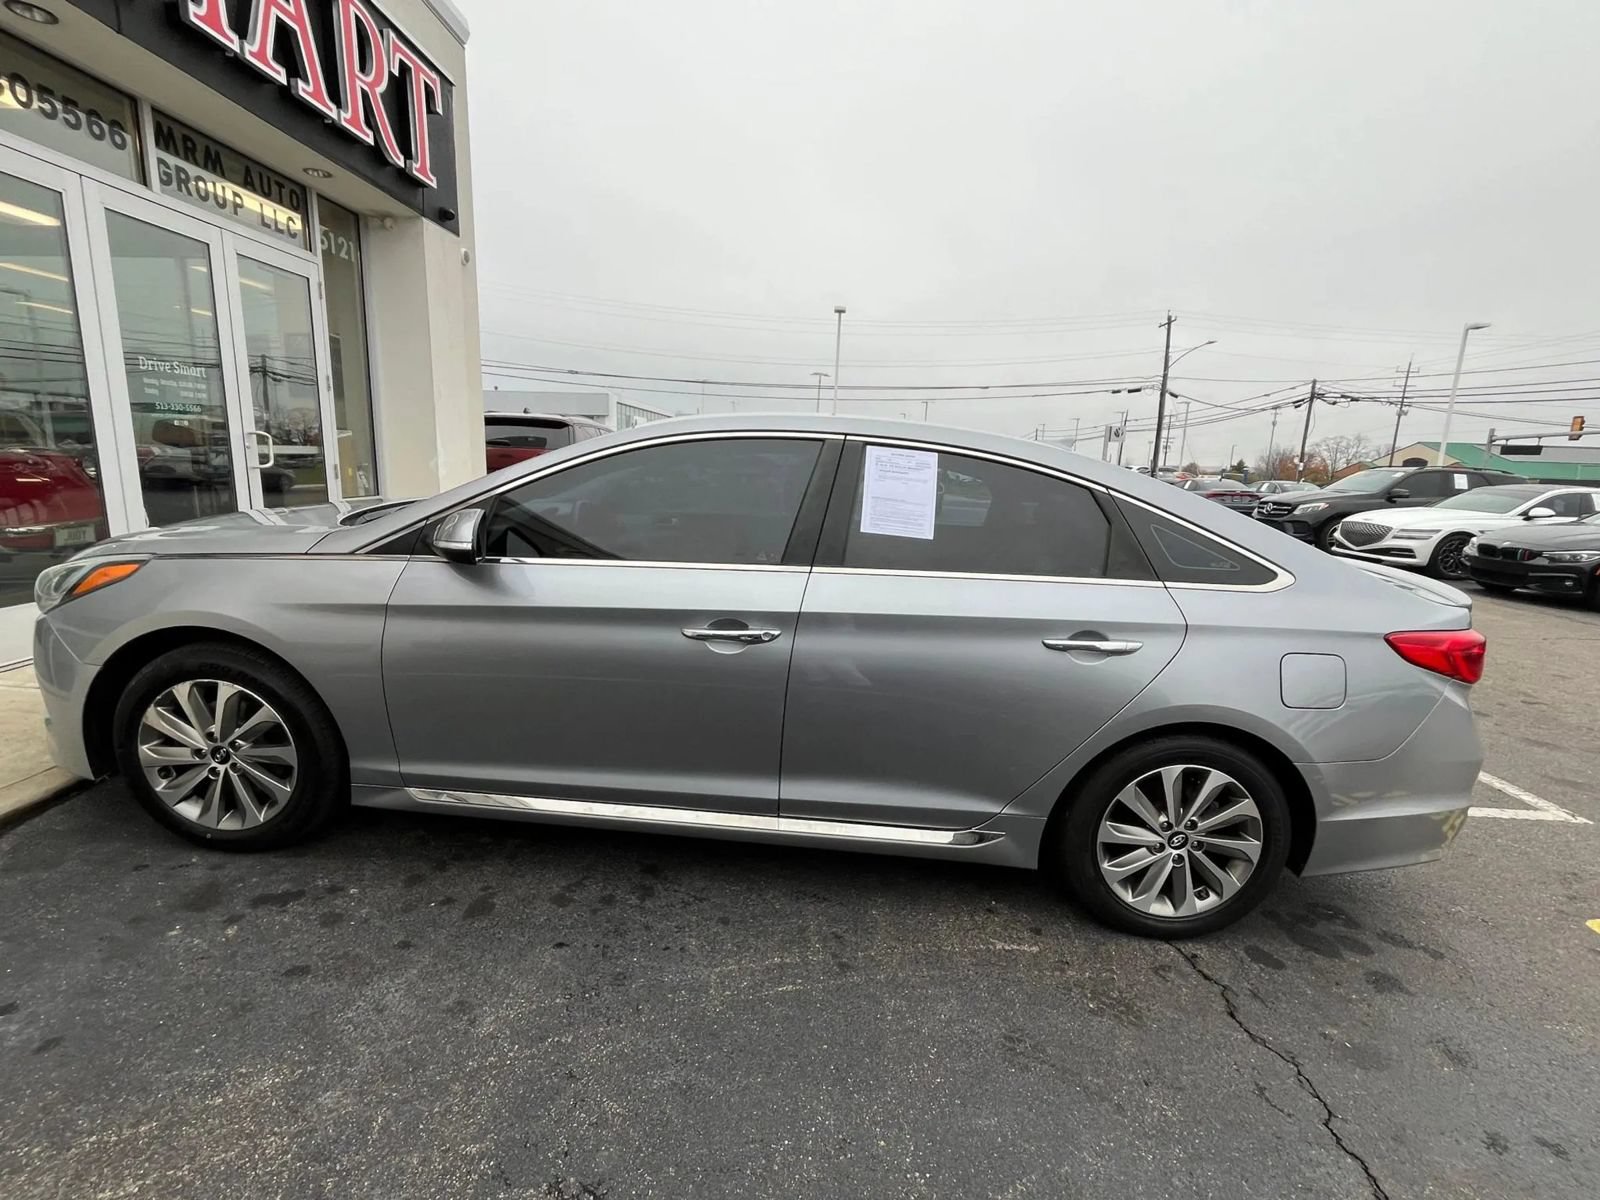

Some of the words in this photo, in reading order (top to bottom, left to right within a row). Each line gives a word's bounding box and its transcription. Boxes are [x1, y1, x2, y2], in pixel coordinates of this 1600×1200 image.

[0, 71, 128, 151] 05566
[189, 0, 443, 189] ART
[154, 120, 226, 179] MRM
[243, 164, 301, 212] AUTO
[156, 156, 245, 217] GROUP
[259, 202, 298, 239] LLC
[138, 356, 171, 373] Drive
[172, 361, 207, 378] Smart
